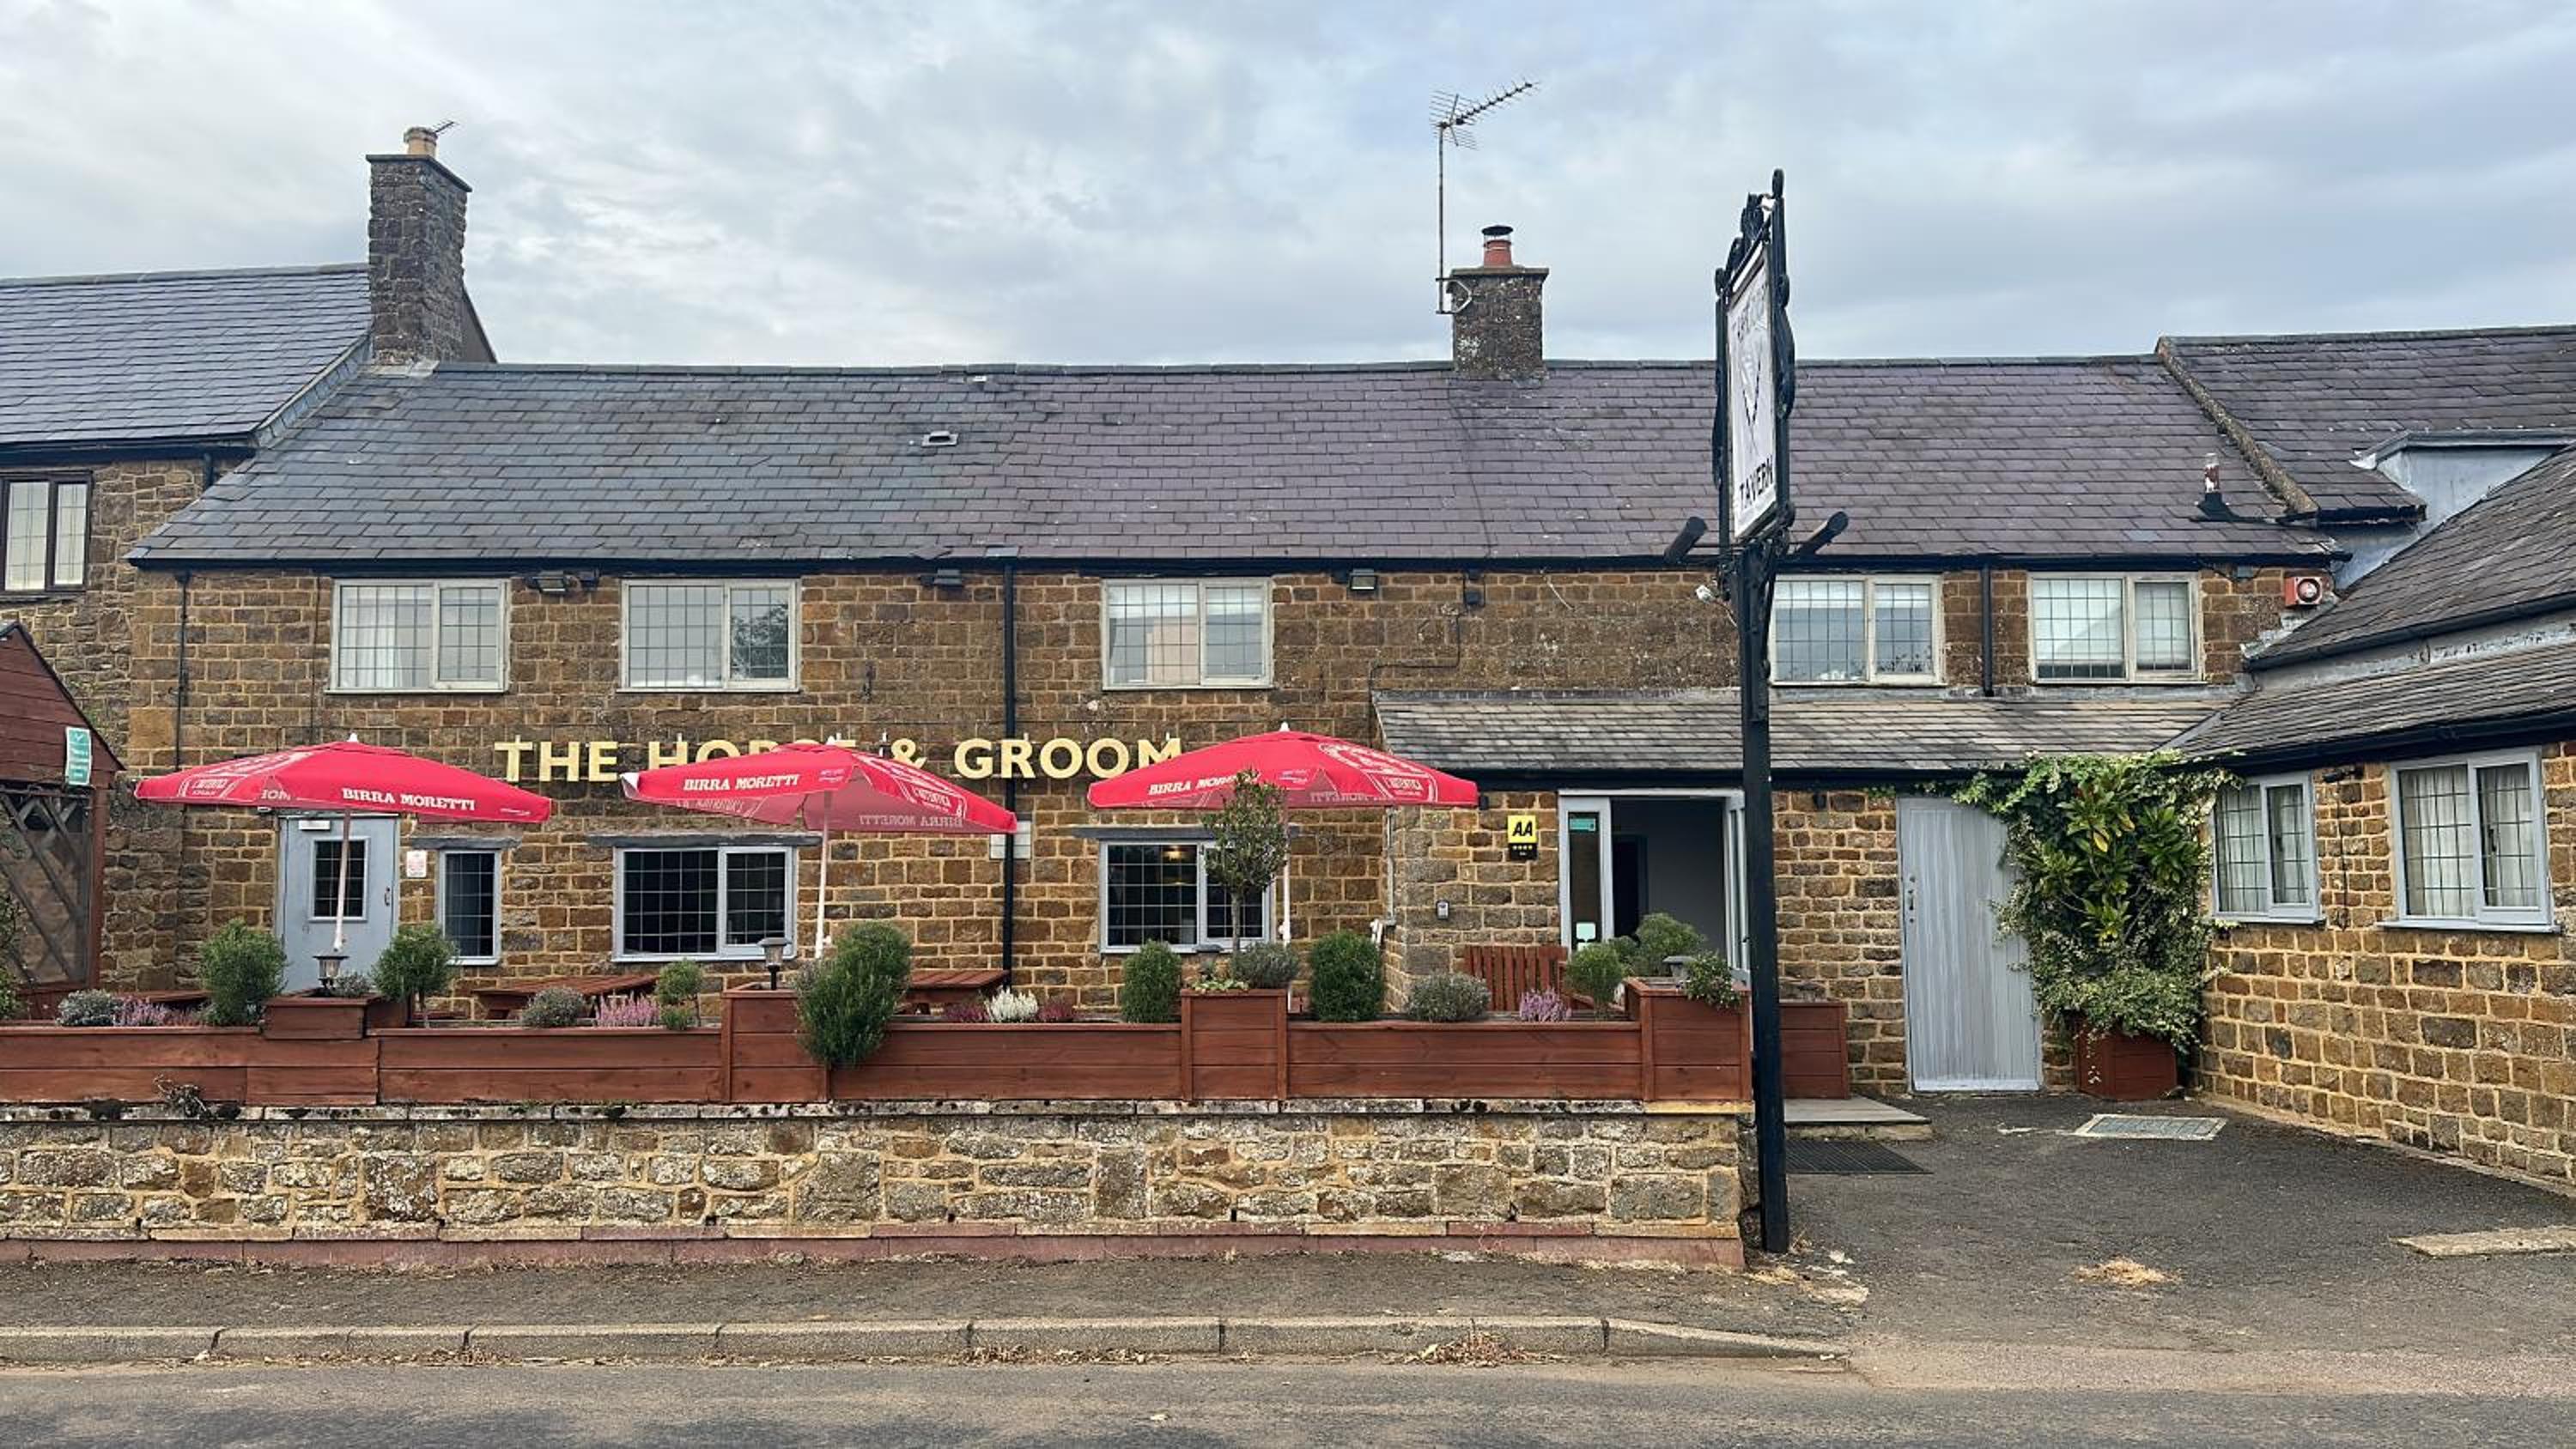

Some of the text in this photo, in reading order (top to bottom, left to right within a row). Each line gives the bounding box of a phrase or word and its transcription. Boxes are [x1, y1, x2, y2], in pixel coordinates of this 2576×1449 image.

[1740, 454, 1773, 510] TAVERN
[494, 740, 620, 782] THE
[890, 738, 927, 769] &
[954, 737, 1182, 779] GROOM
[683, 773, 800, 791] BIRRA MORETTI
[1148, 781, 1191, 796] BIRRA
[342, 787, 476, 811] BIRRA MORETTI
[1512, 821, 1533, 836] AA
